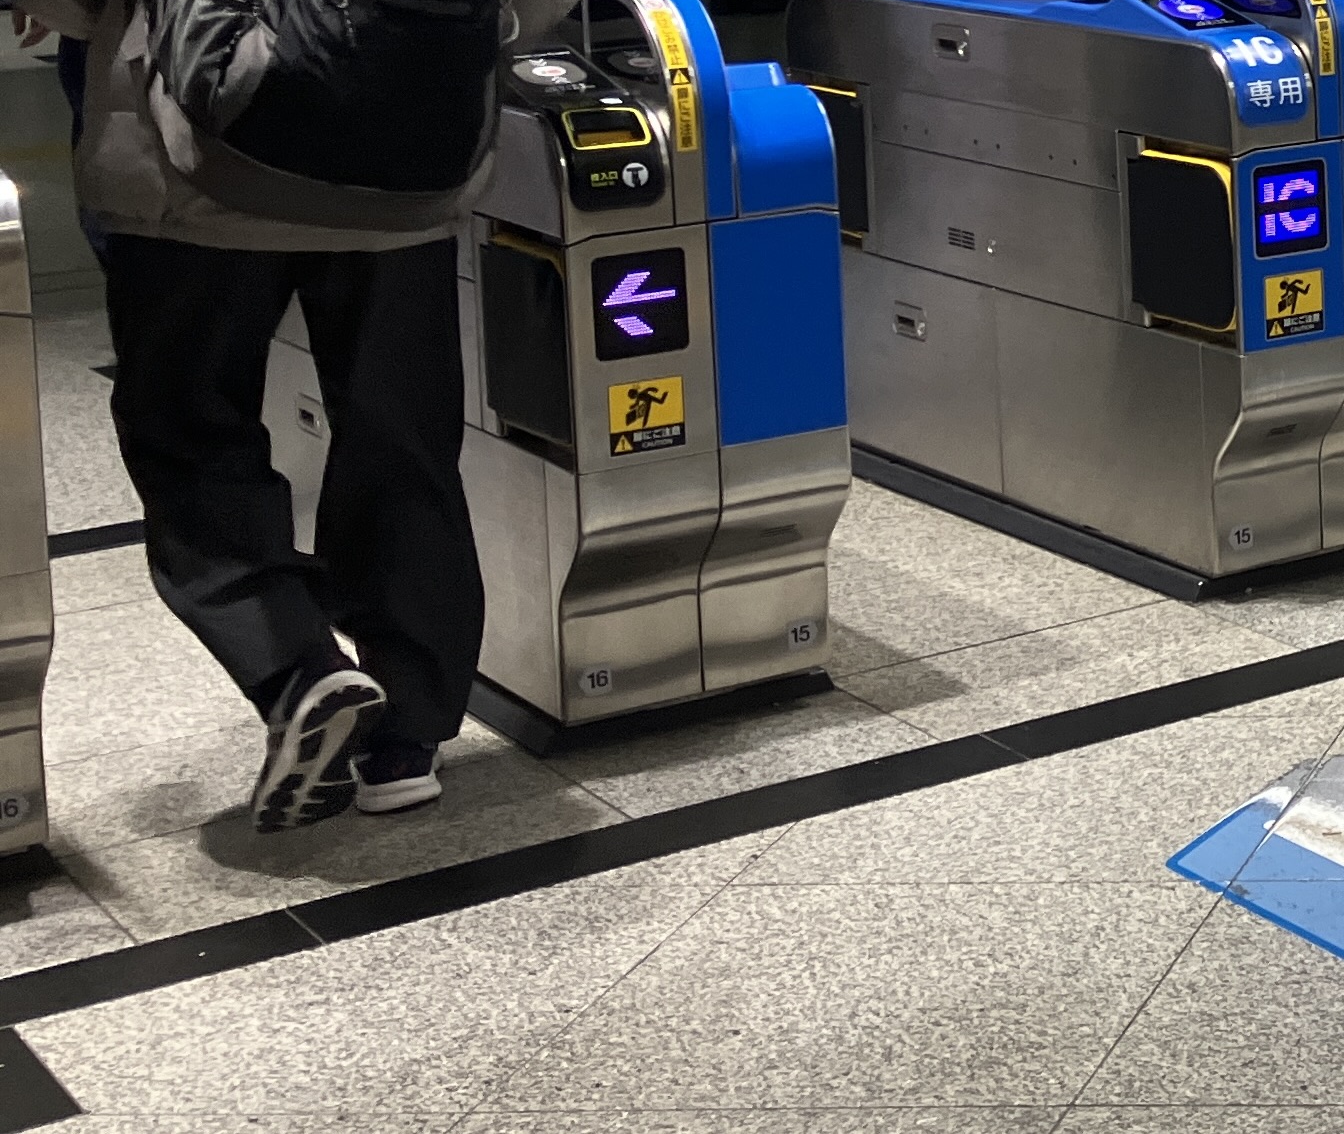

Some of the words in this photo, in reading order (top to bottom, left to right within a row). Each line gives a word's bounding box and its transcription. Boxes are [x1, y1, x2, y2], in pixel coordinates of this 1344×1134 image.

[1231, 35, 1284, 67] IC
[1246, 77, 1305, 109] 専用
[1234, 527, 1251, 545] 15
[790, 624, 811, 643] 15
[586, 669, 609, 689] 16
